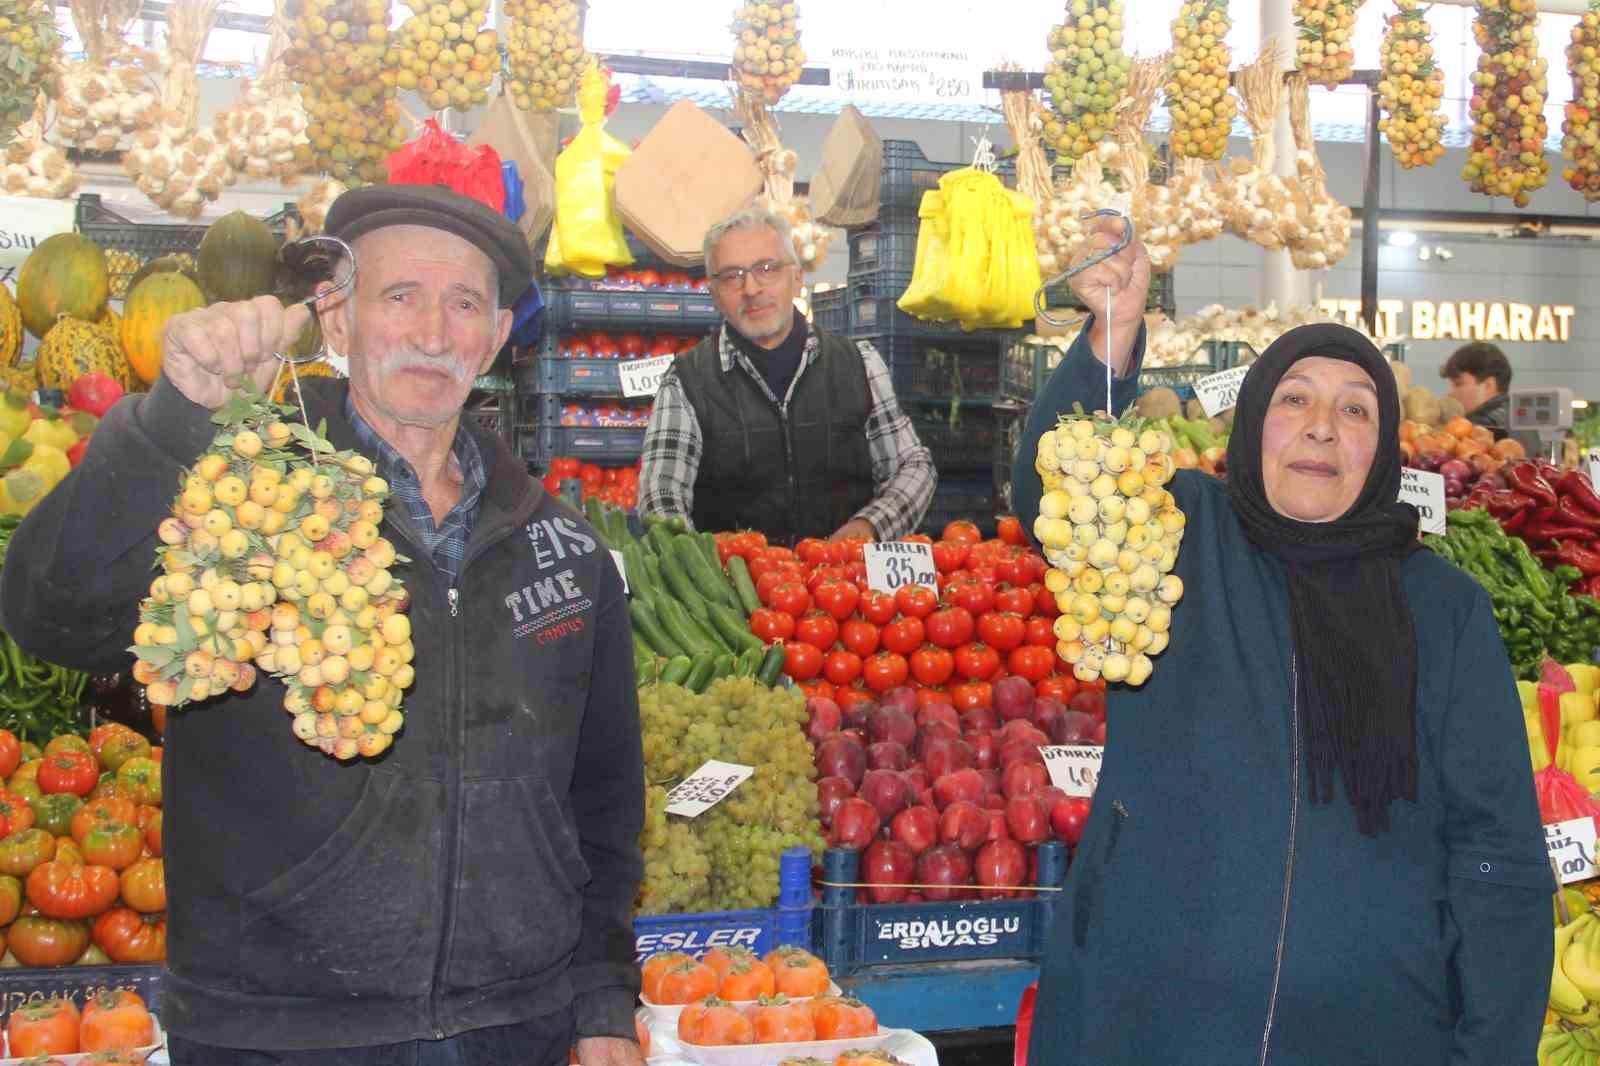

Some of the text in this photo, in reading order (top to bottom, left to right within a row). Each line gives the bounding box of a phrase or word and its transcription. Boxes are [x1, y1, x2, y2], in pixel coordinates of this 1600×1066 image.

[1411, 301, 1575, 341] BAHARAT
[541, 516, 597, 560] IS
[505, 569, 583, 622] TIME
[536, 617, 585, 646] CAMPUS
